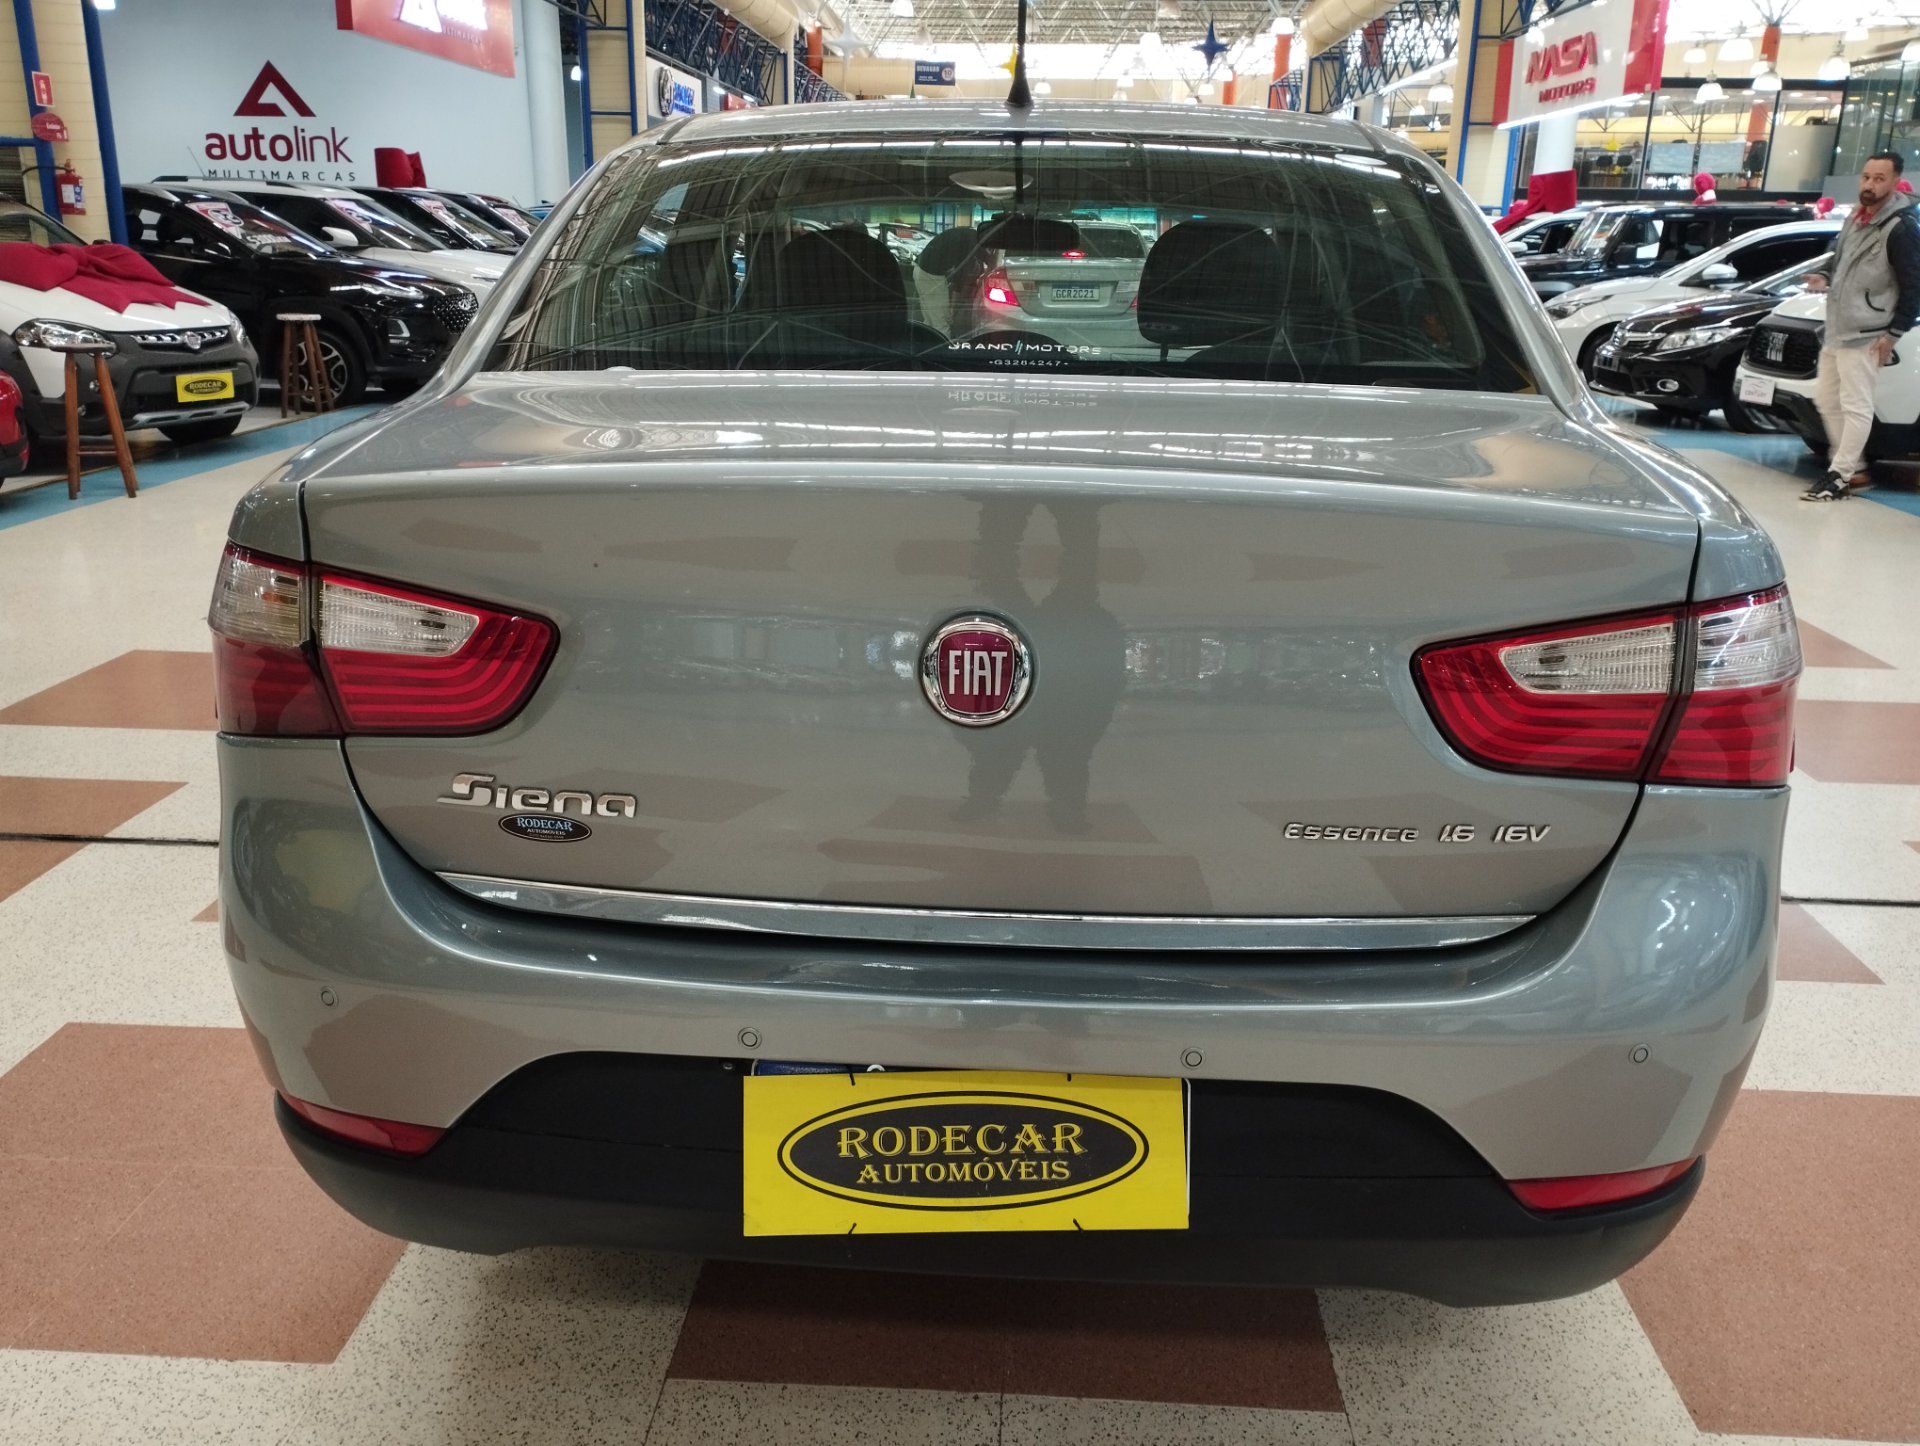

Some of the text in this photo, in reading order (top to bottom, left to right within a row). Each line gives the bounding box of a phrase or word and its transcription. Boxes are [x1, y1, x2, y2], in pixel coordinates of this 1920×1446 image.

[1525, 31, 1598, 84] NASA
[1538, 77, 1597, 103] MOTORS
[205, 125, 354, 163] autolink
[207, 169, 356, 182] MULTIMARCAS
[1055, 289, 1095, 299] GCR2C21
[1026, 344, 1102, 355] MOTORS
[190, 381, 223, 389] RODECAR
[948, 649, 1008, 696] FIAT
[436, 773, 637, 819] Siena
[517, 817, 573, 831] RODECAR
[1284, 822, 1420, 843] Essence
[1491, 824, 1552, 844] 16V
[837, 1122, 1088, 1159] RODECAR
[856, 1157, 1073, 1184] AUTOMÓVEIS
